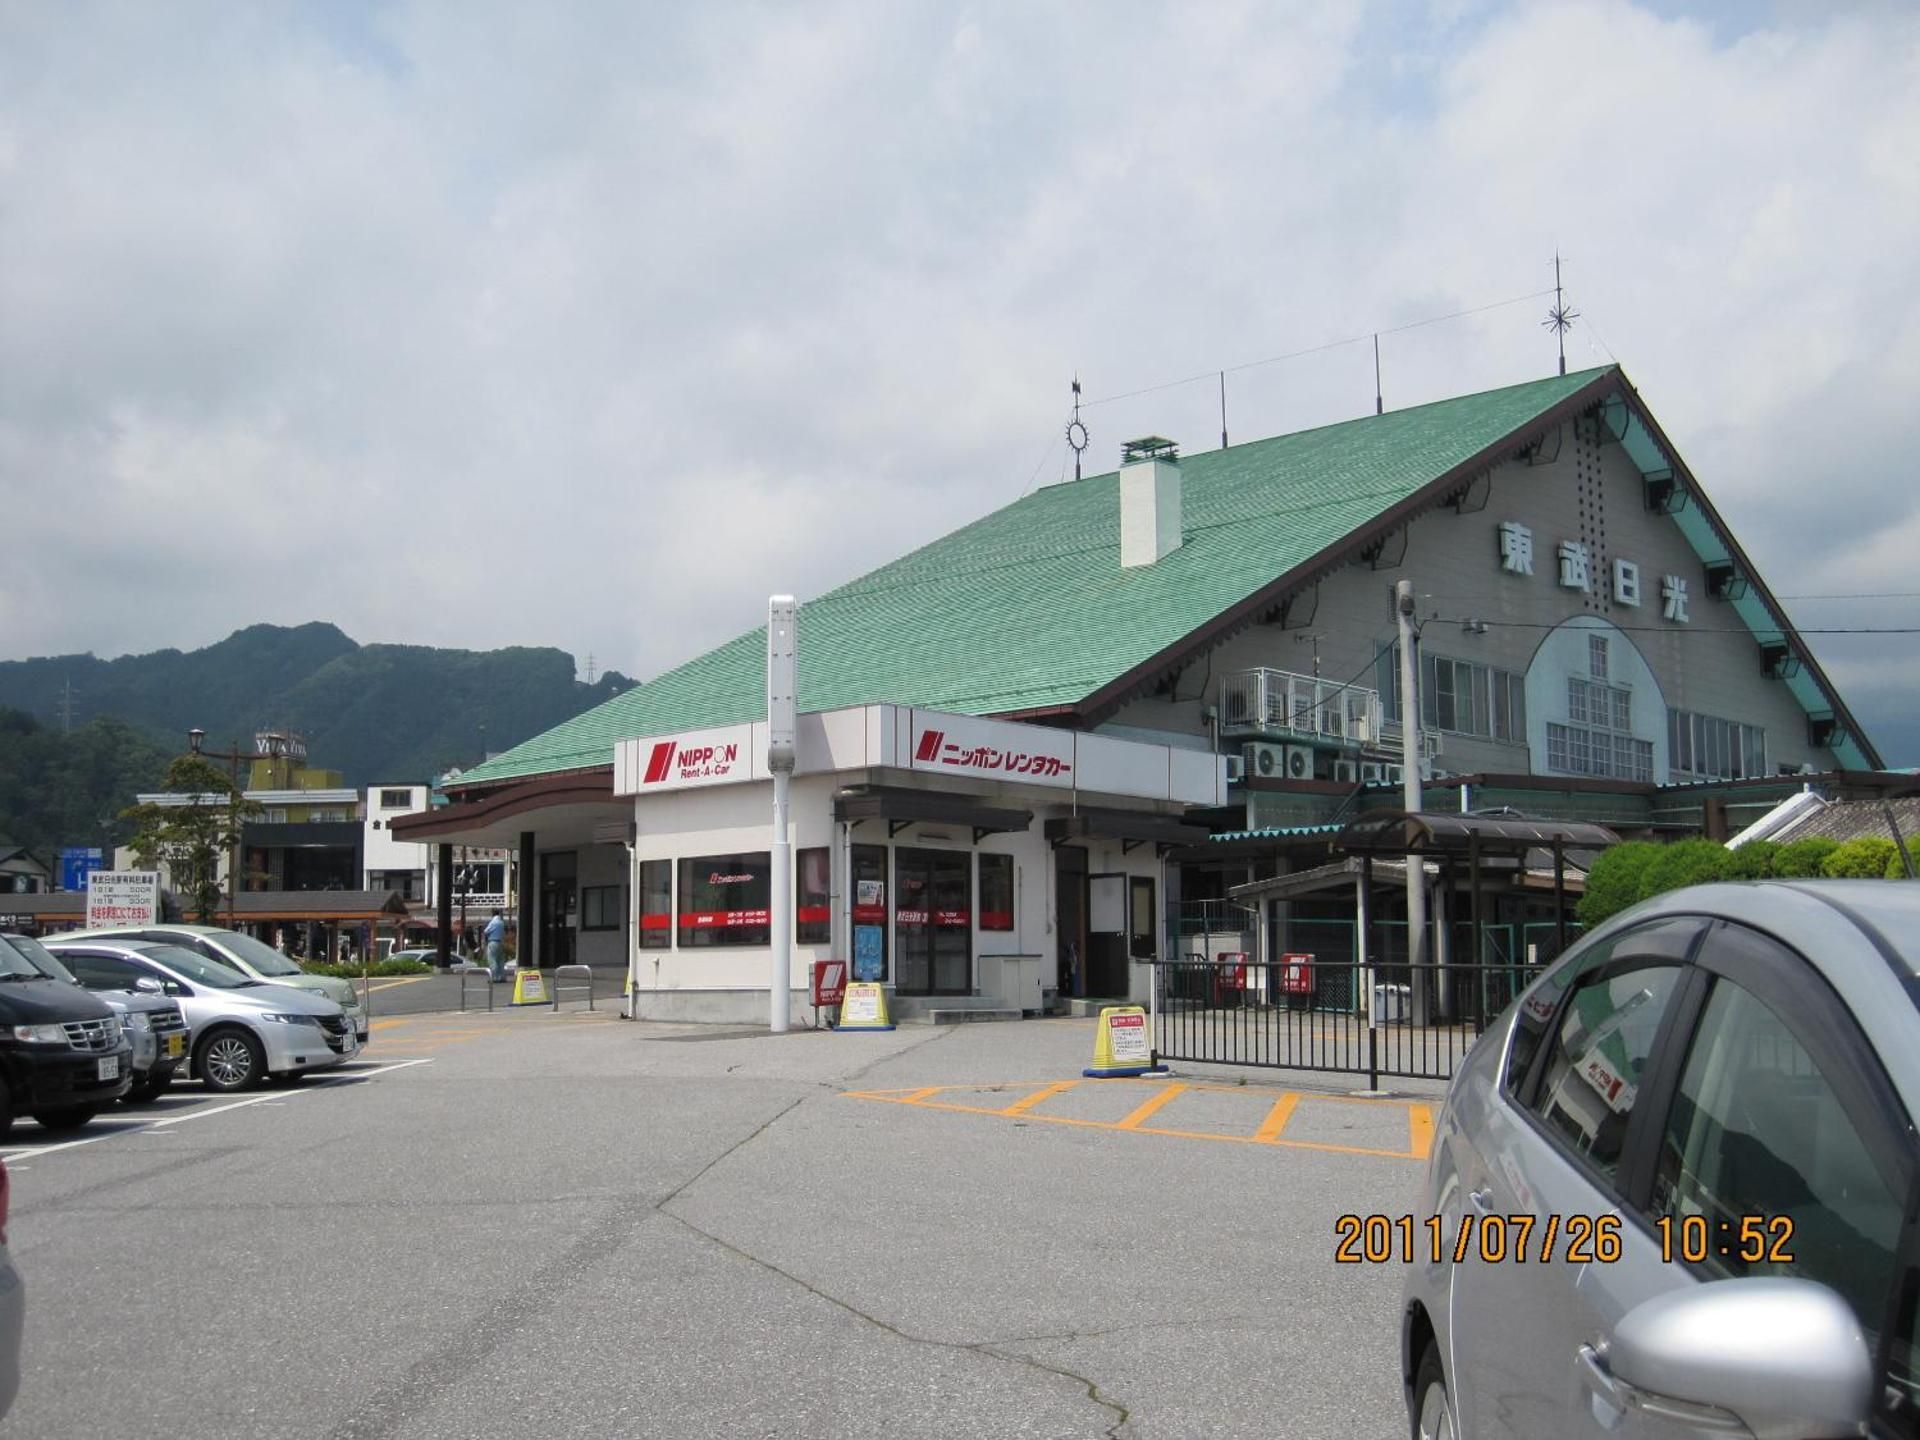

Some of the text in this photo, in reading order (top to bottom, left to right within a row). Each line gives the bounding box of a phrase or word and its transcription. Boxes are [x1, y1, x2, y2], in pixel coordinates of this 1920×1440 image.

[1499, 521, 1690, 623] 東武日光
[677, 744, 737, 768] NIPPON
